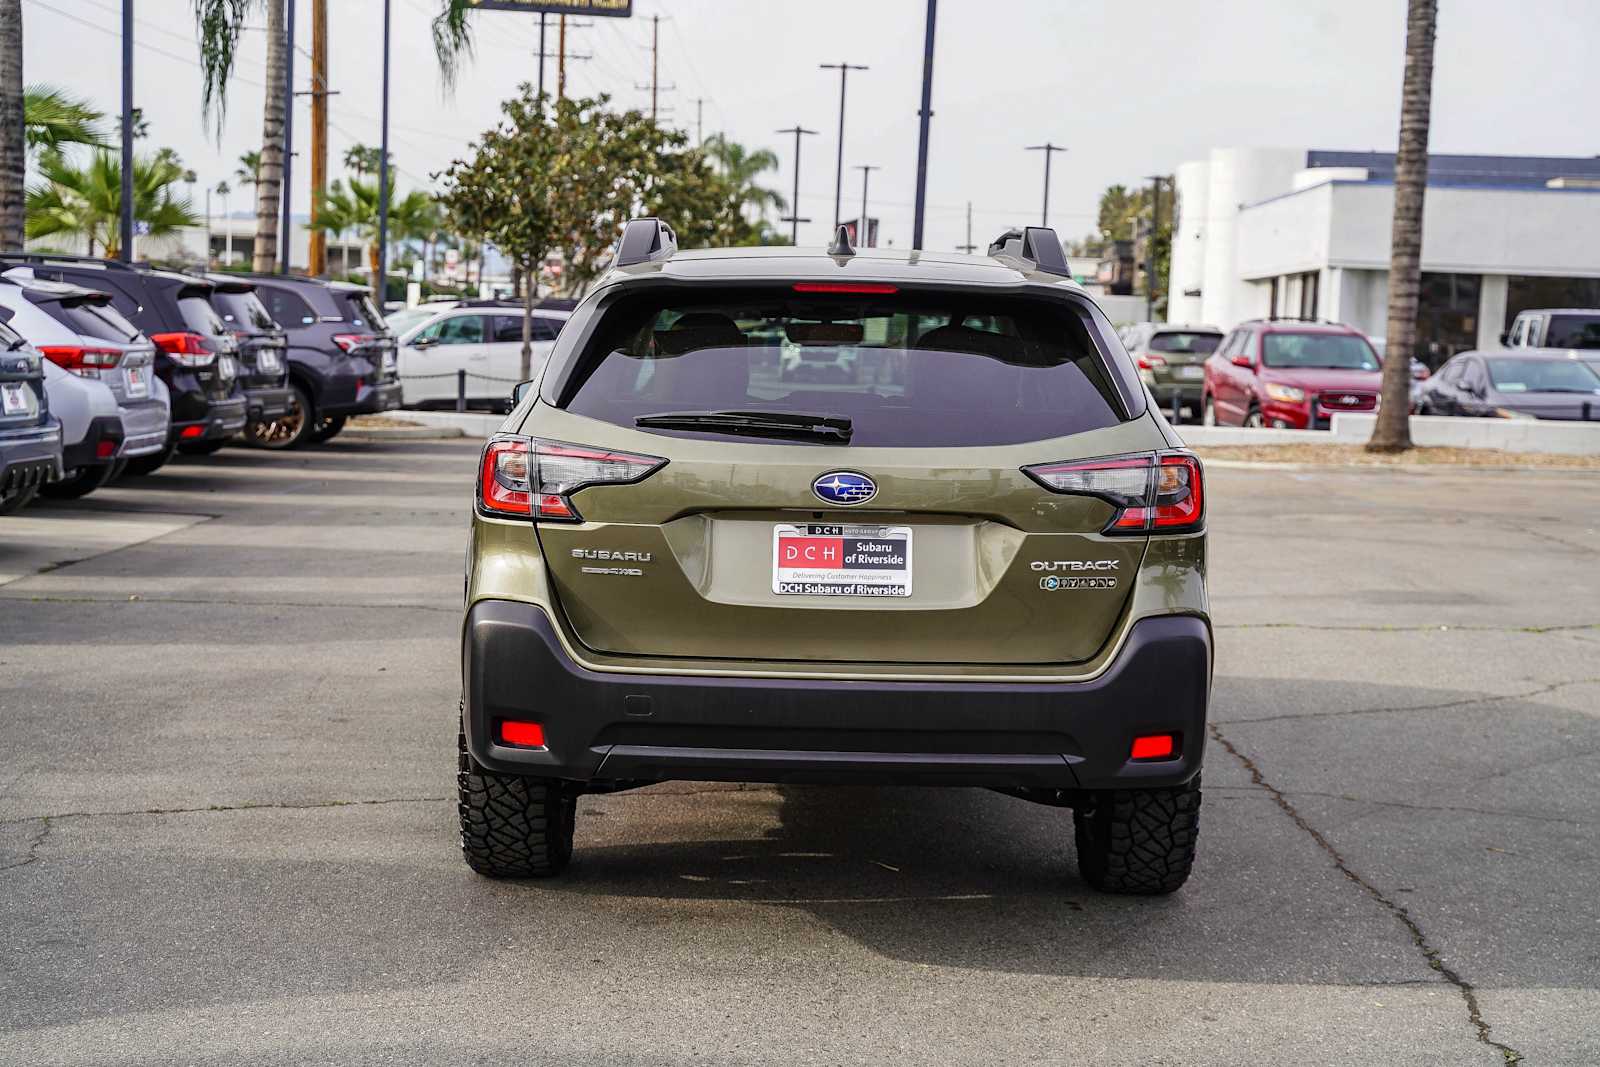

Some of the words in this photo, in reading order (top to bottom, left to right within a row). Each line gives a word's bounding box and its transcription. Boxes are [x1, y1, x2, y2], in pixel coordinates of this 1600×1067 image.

[815, 526, 839, 534] DCH
[856, 542, 892, 552] Subaru
[571, 549, 651, 562] SUBARU
[786, 545, 835, 561] DCH
[845, 554, 857, 564] of
[858, 554, 904, 565] Riverside
[1030, 560, 1120, 571] OUTBACK
[793, 572, 825, 580] Delivering
[780, 583, 803, 593] DCH
[804, 583, 842, 594] Subaru
[843, 584, 856, 594] of
[857, 585, 905, 595] Riverside
